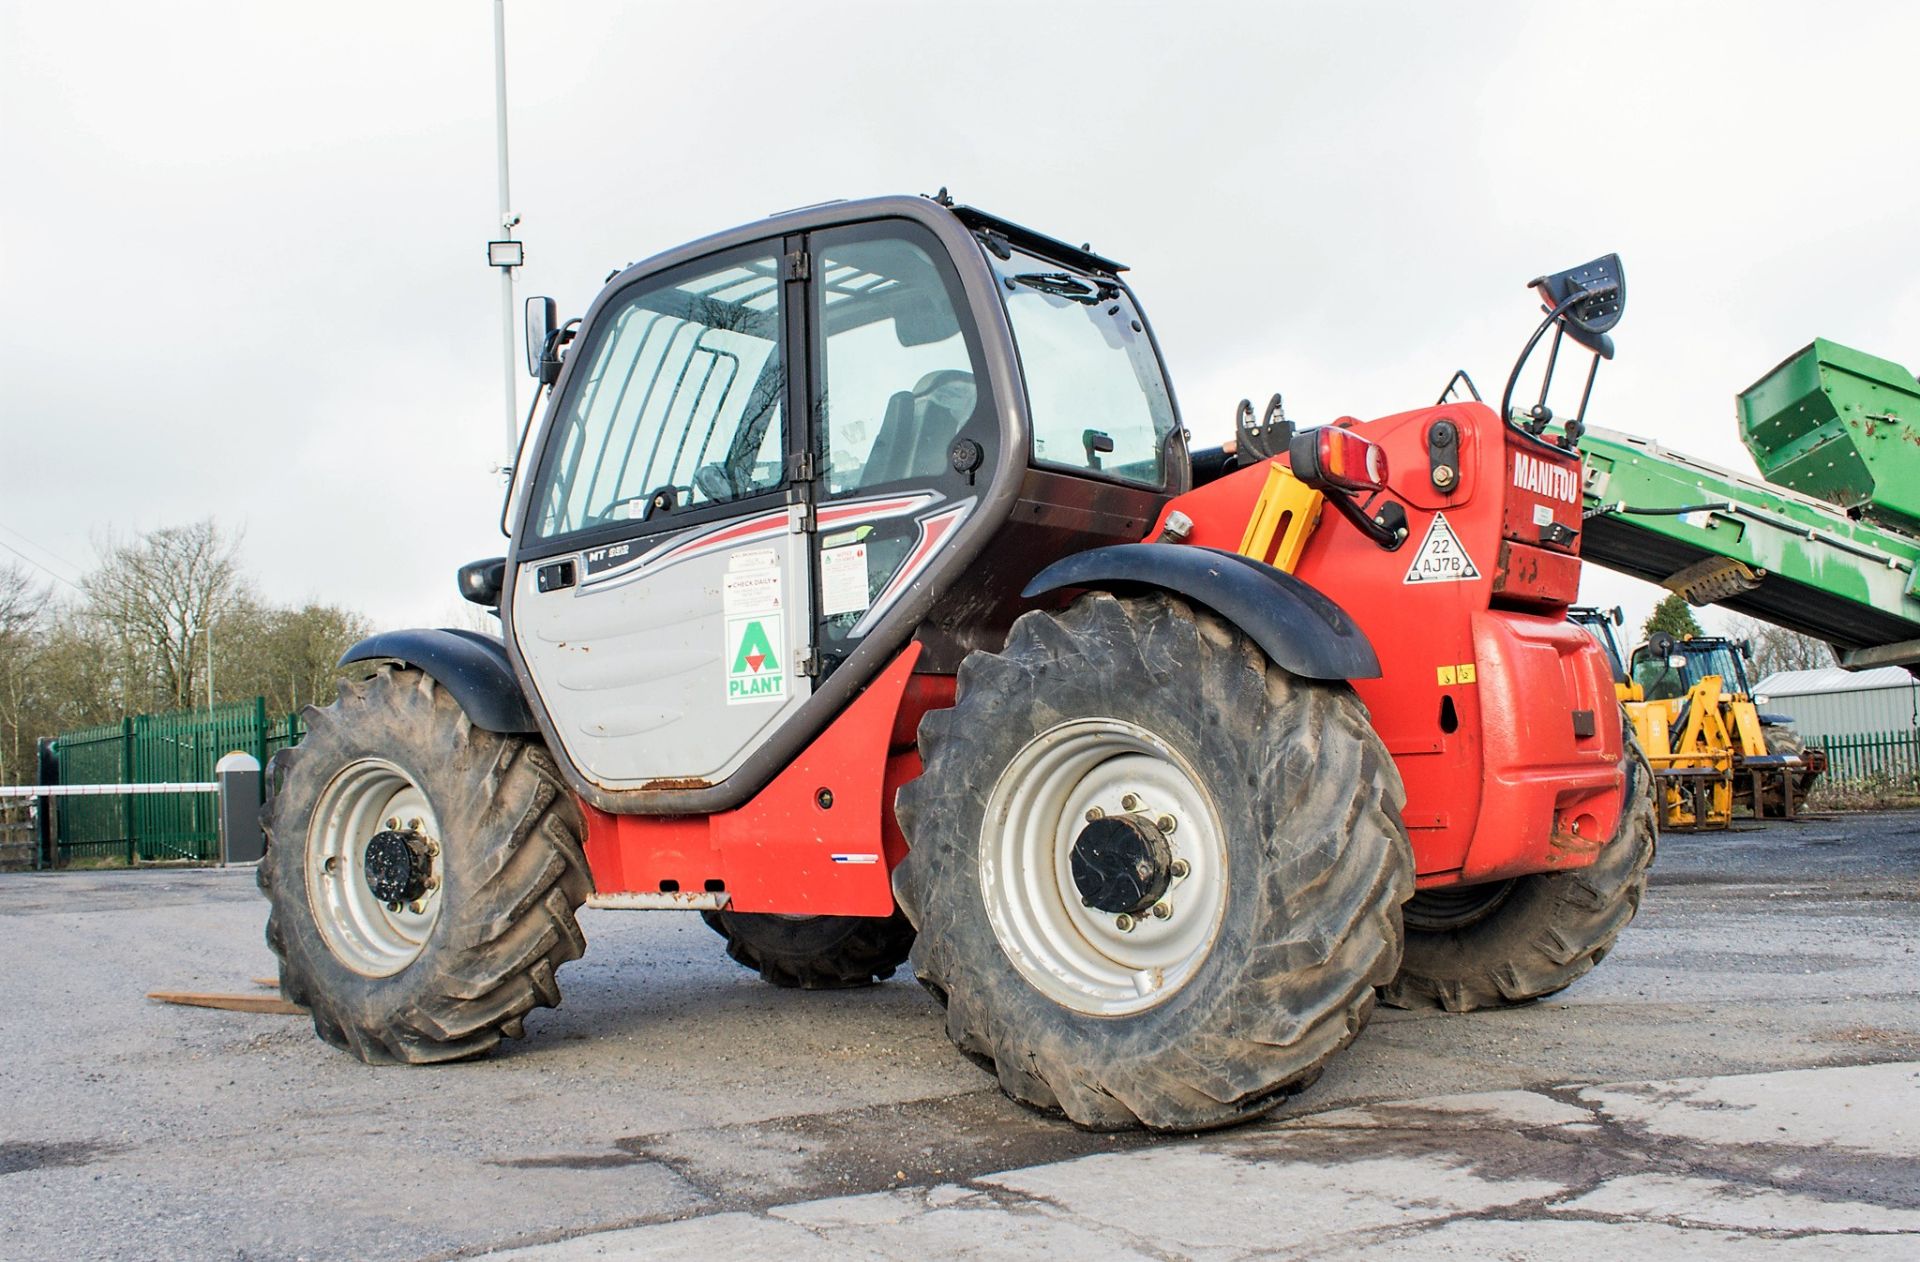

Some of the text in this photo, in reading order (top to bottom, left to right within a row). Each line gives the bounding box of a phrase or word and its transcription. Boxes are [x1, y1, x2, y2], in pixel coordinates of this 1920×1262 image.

[1513, 451, 1578, 504] MANITOU
[1432, 540, 1450, 554] 22
[589, 549, 607, 563] MT
[1423, 557, 1461, 573] AJ7B
[732, 577, 771, 588] CHECK DAILY
[732, 621, 779, 673] A
[729, 676, 783, 696] PLANT
